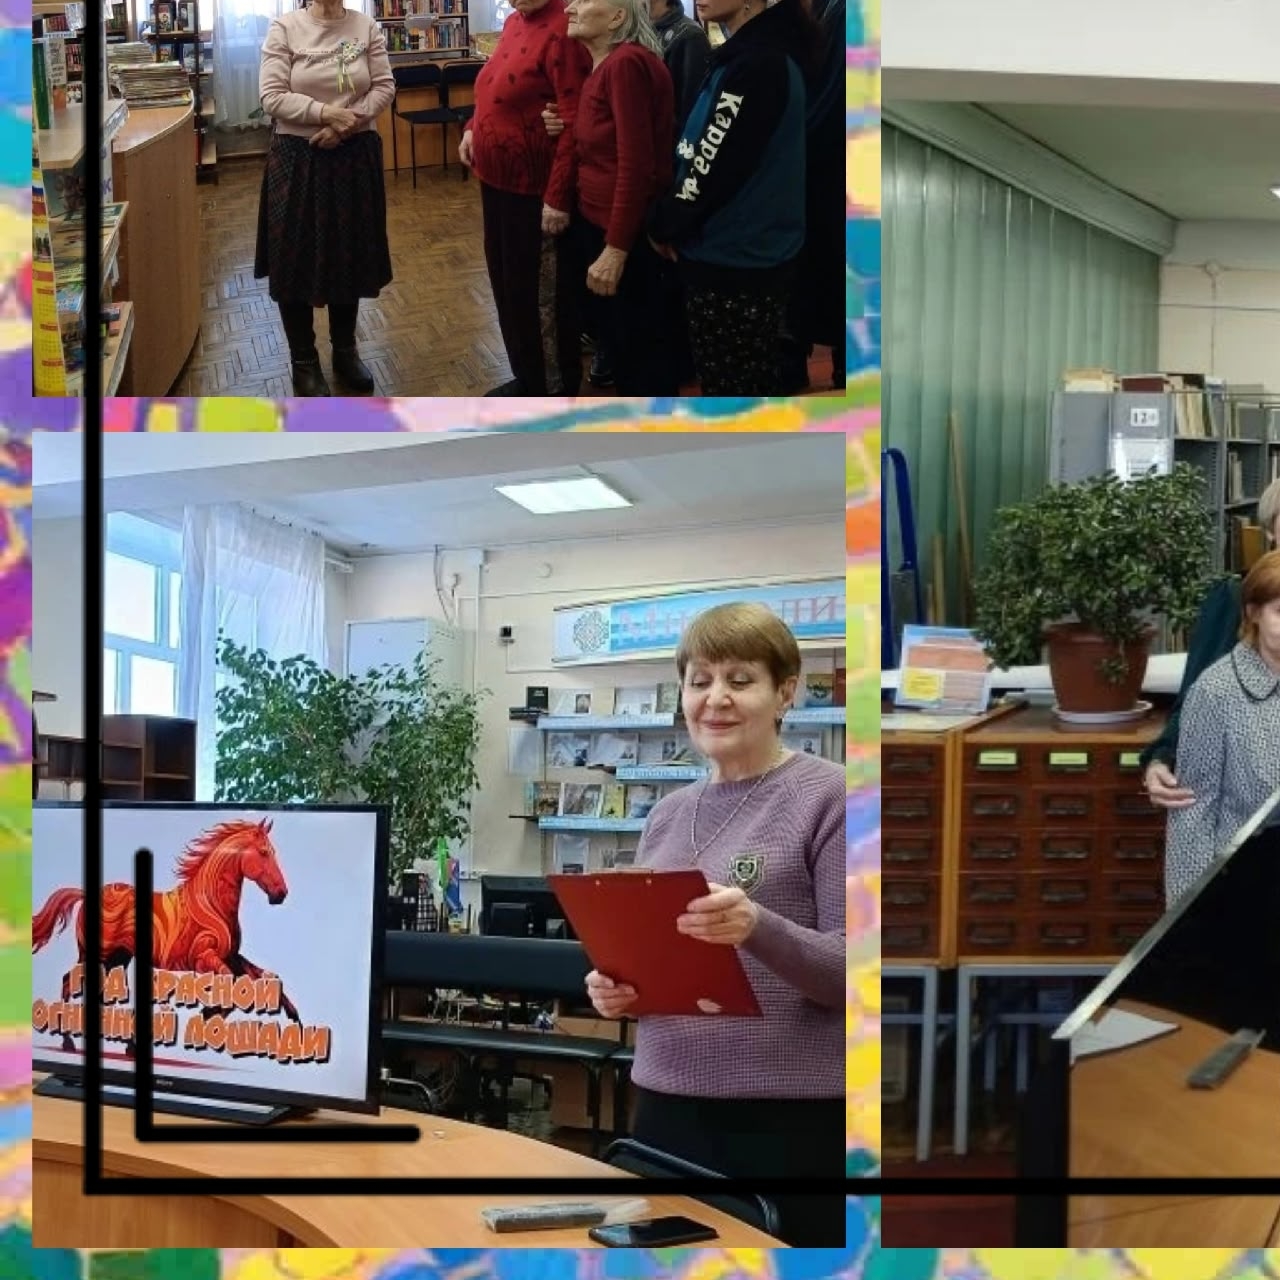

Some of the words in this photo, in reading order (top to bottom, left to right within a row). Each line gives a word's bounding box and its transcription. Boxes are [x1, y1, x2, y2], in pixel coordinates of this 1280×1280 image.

[694, 91, 744, 176] Kappa
[69, 963, 130, 1004] ГД
[152, 969, 283, 1014] РАСНОЙ
[32, 999, 177, 1047] ОГНННЙ
[184, 1013, 332, 1064] ЛОШАДИ
